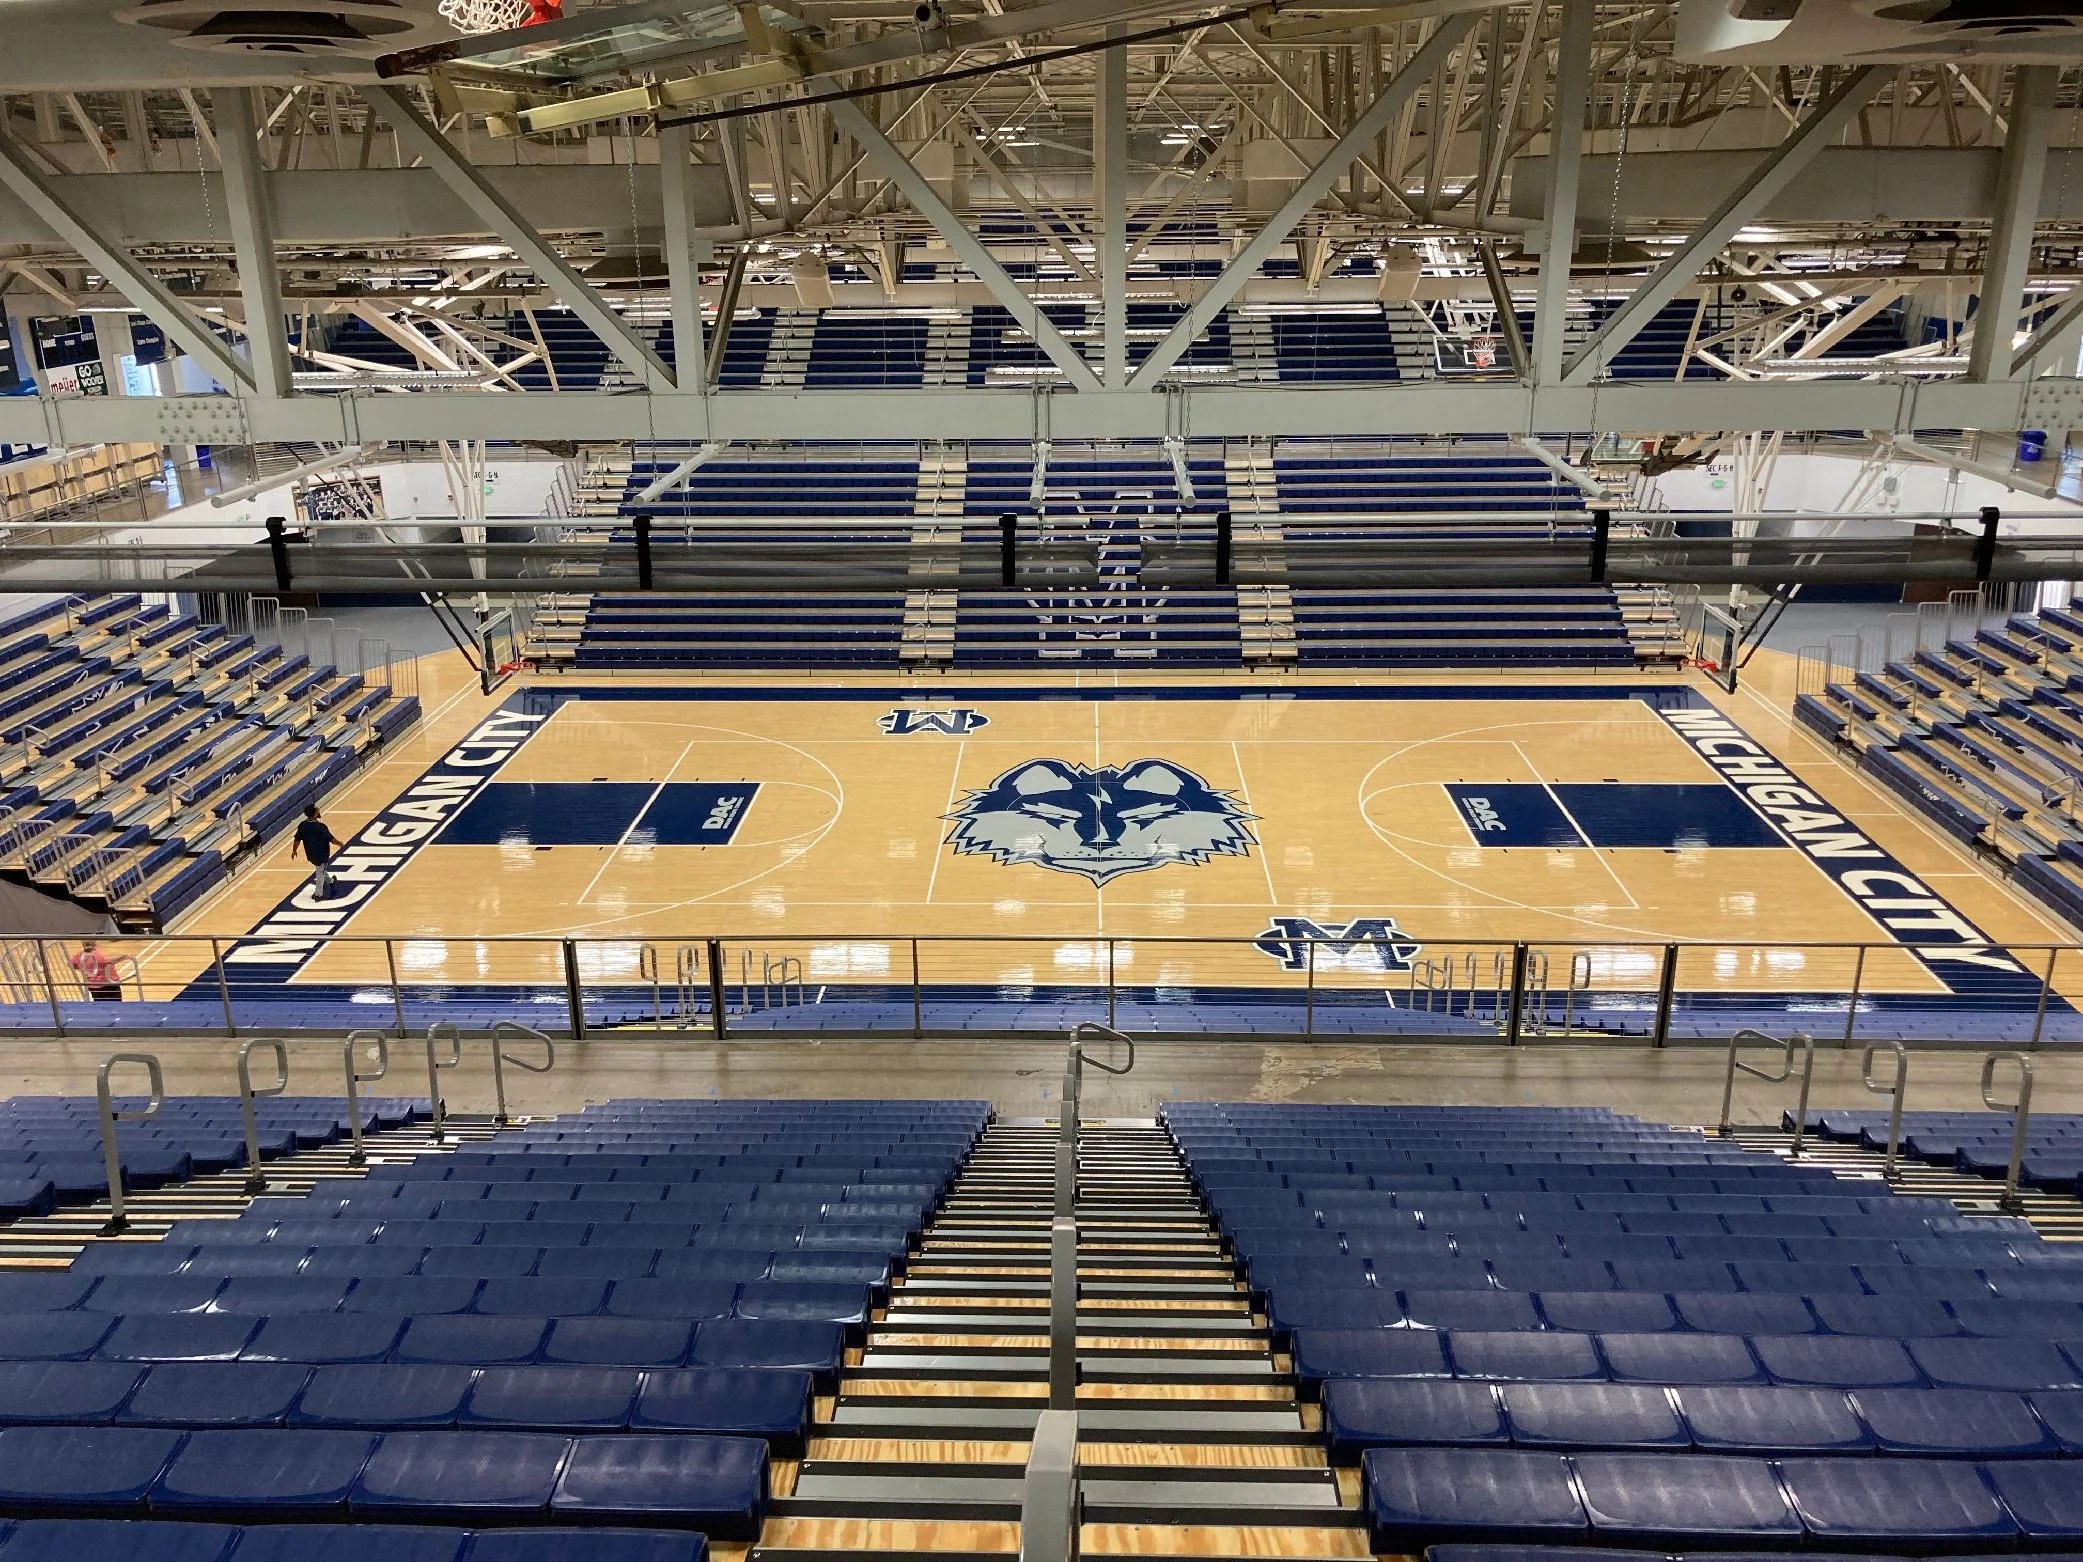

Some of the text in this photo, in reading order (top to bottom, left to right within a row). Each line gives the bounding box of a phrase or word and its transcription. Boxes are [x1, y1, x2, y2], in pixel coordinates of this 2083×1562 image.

[78, 365, 92, 378] GO
[701, 797, 738, 829] DAC
[1467, 797, 1507, 830] DAC
[223, 709, 547, 963] MICHIGAN CITY
[1658, 709, 2024, 973] MICHIGAN CITY
